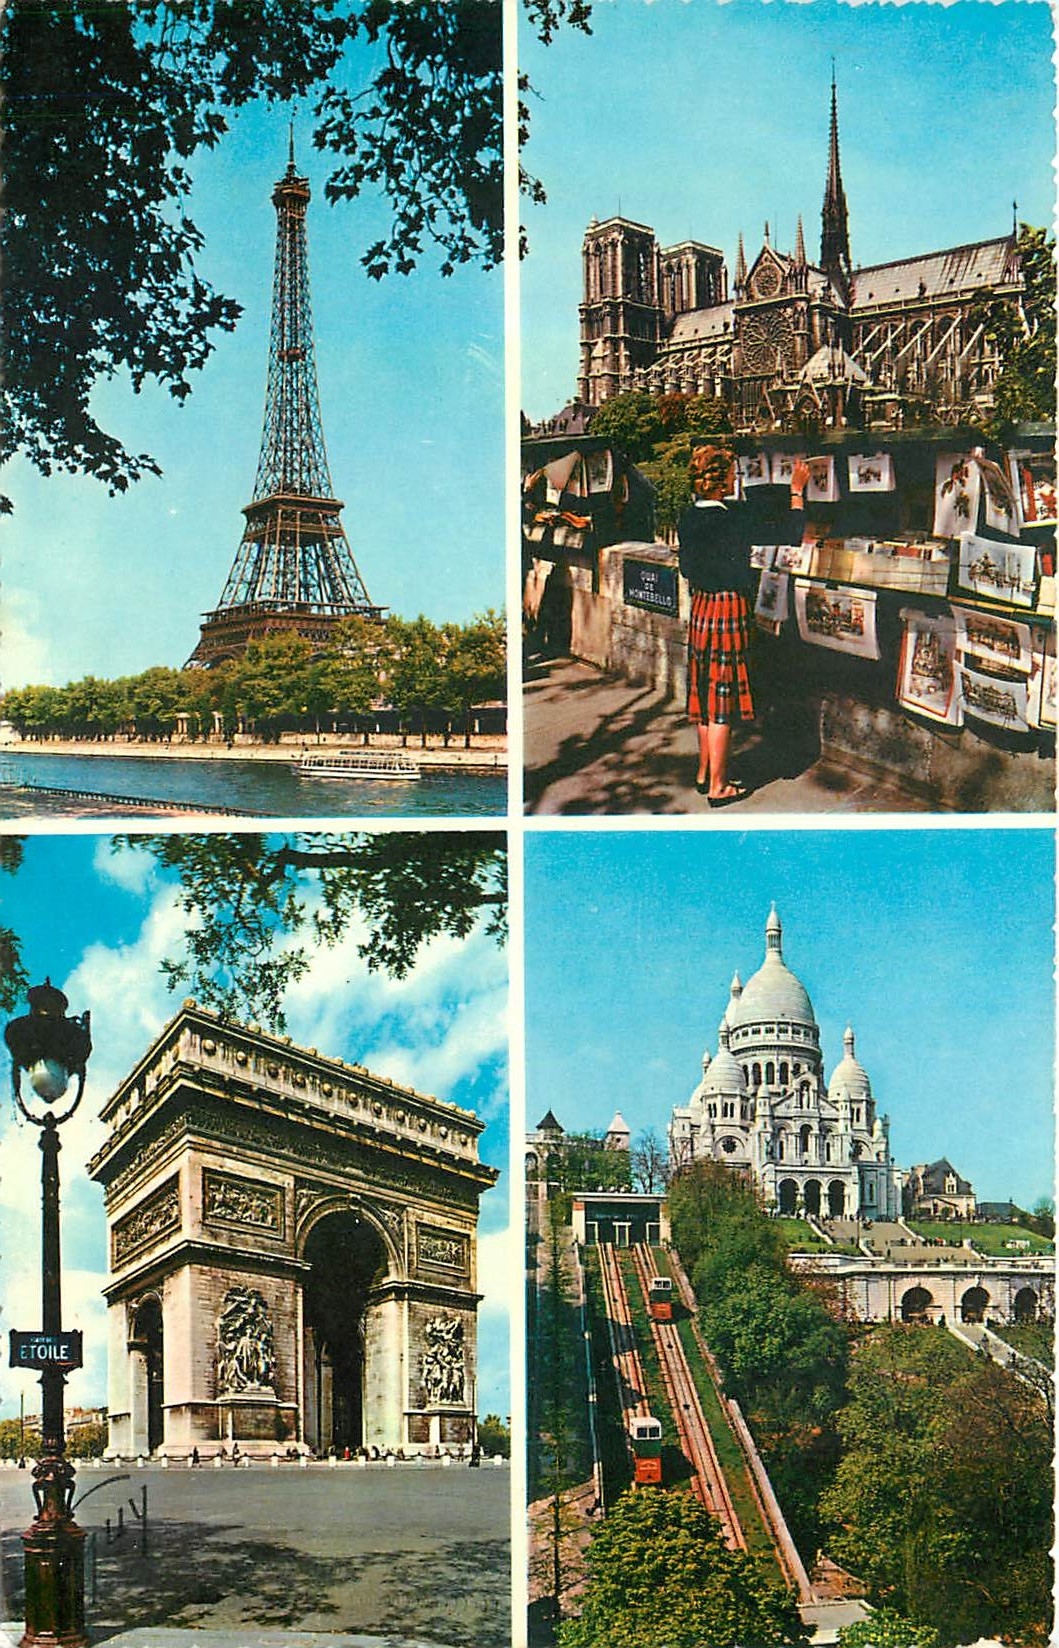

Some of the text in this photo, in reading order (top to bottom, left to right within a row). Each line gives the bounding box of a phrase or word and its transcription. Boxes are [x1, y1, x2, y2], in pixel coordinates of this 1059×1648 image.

[640, 571, 658, 582] QUAI
[644, 583, 654, 591] DE
[629, 588, 672, 606] MONTEBELLO
[20, 1345, 69, 1359] ETOILE
